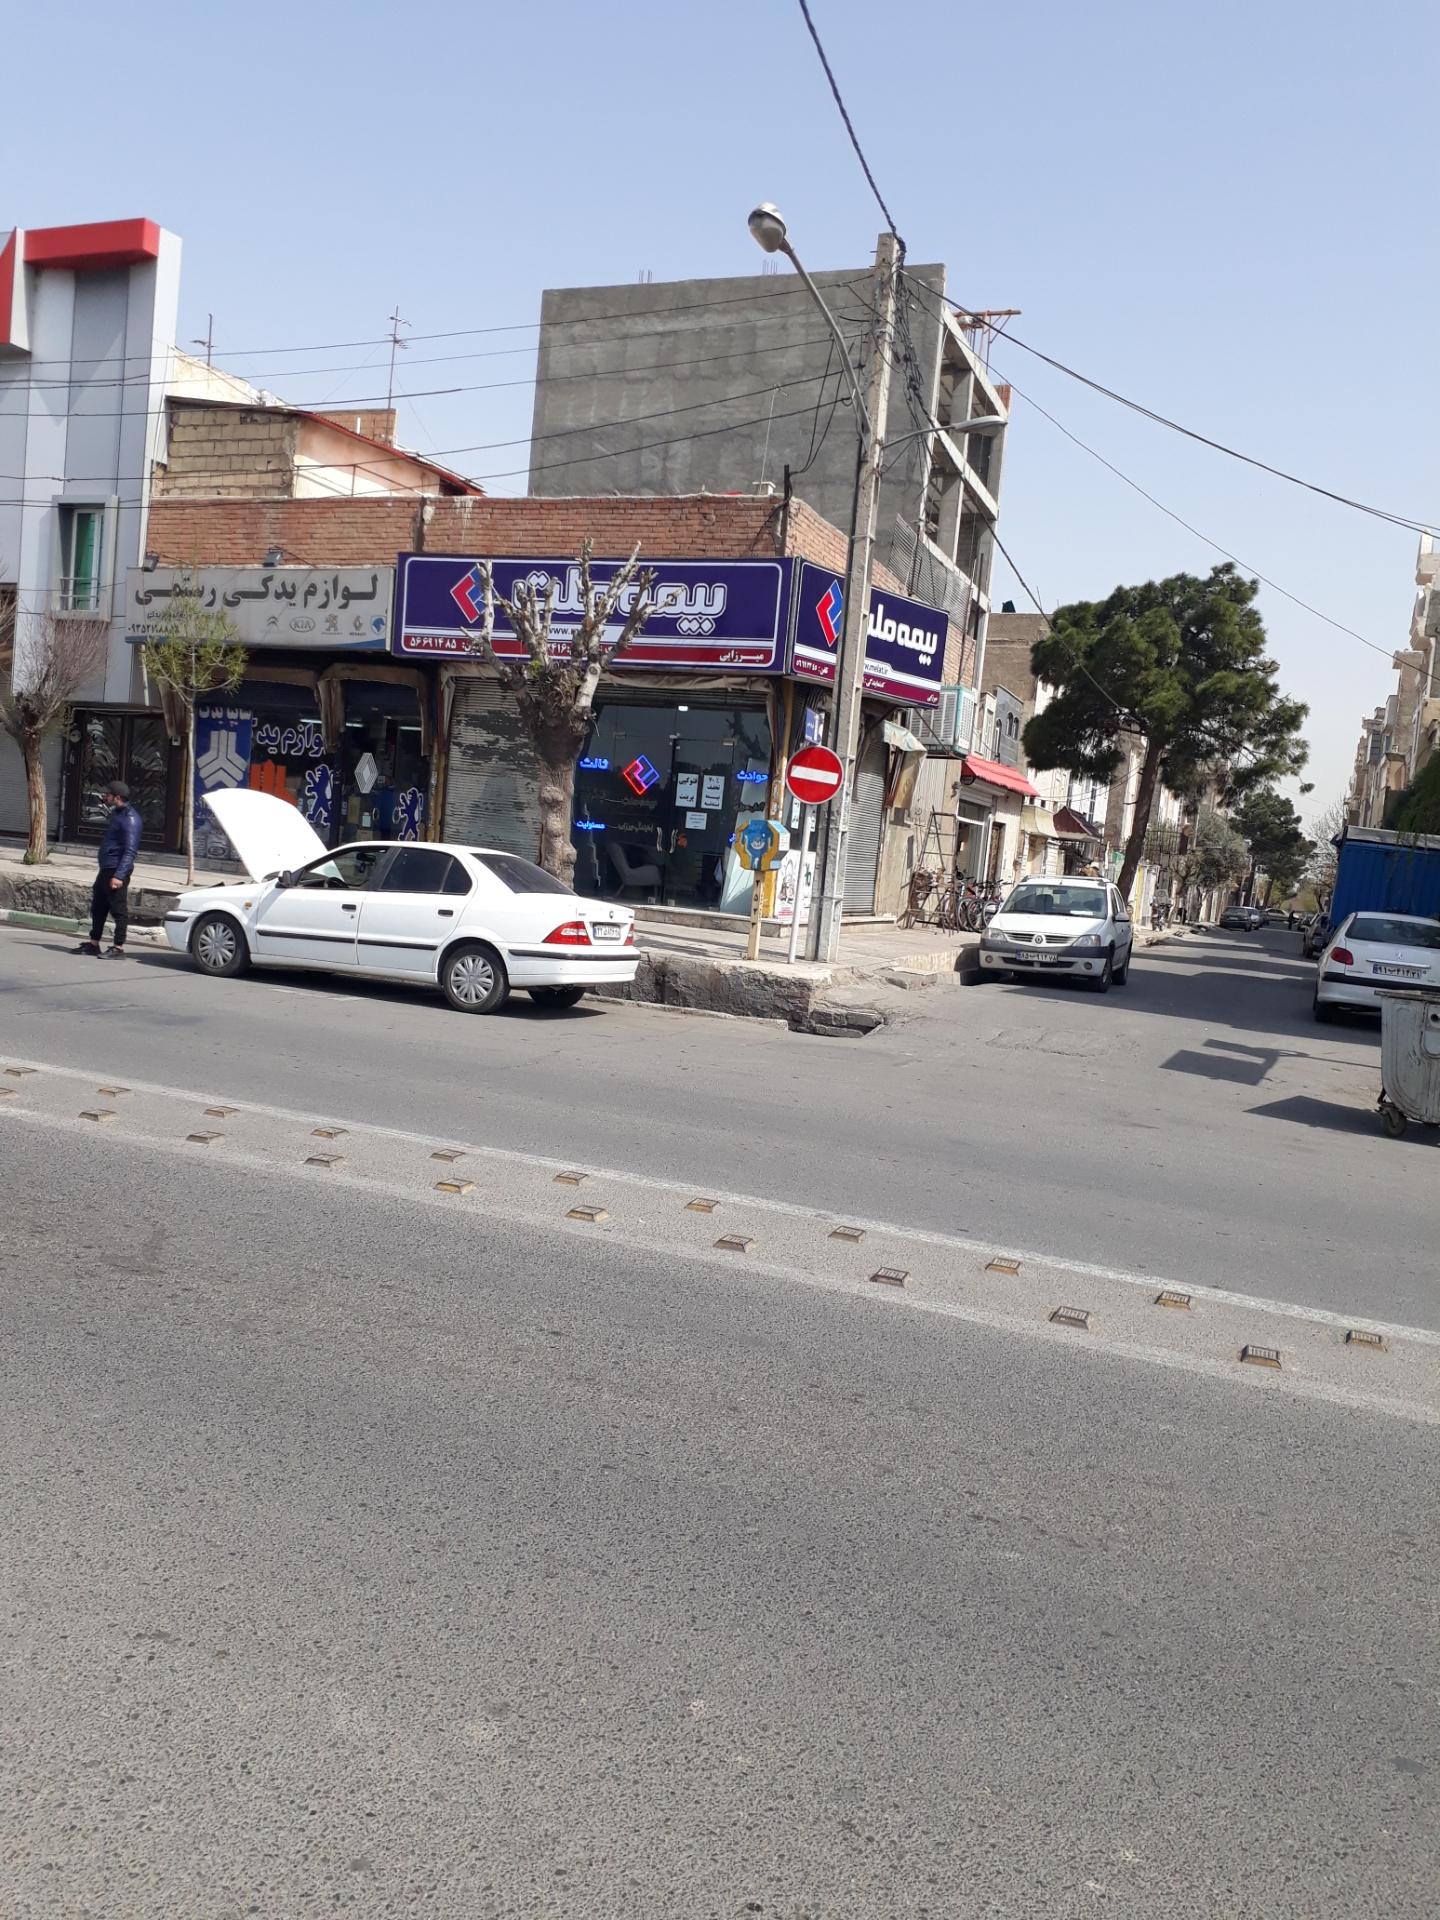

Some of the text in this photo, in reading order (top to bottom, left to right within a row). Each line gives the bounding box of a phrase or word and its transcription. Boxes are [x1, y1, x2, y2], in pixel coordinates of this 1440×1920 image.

[134, 573, 379, 610] لوازم یدکی رستمی
[617, 583, 727, 634] بیمه
[867, 603, 938, 666] بیمه مل
[719, 650, 764, 663] میرزایی
[280, 721, 326, 757] وازم
[735, 767, 769, 783] حوادث
